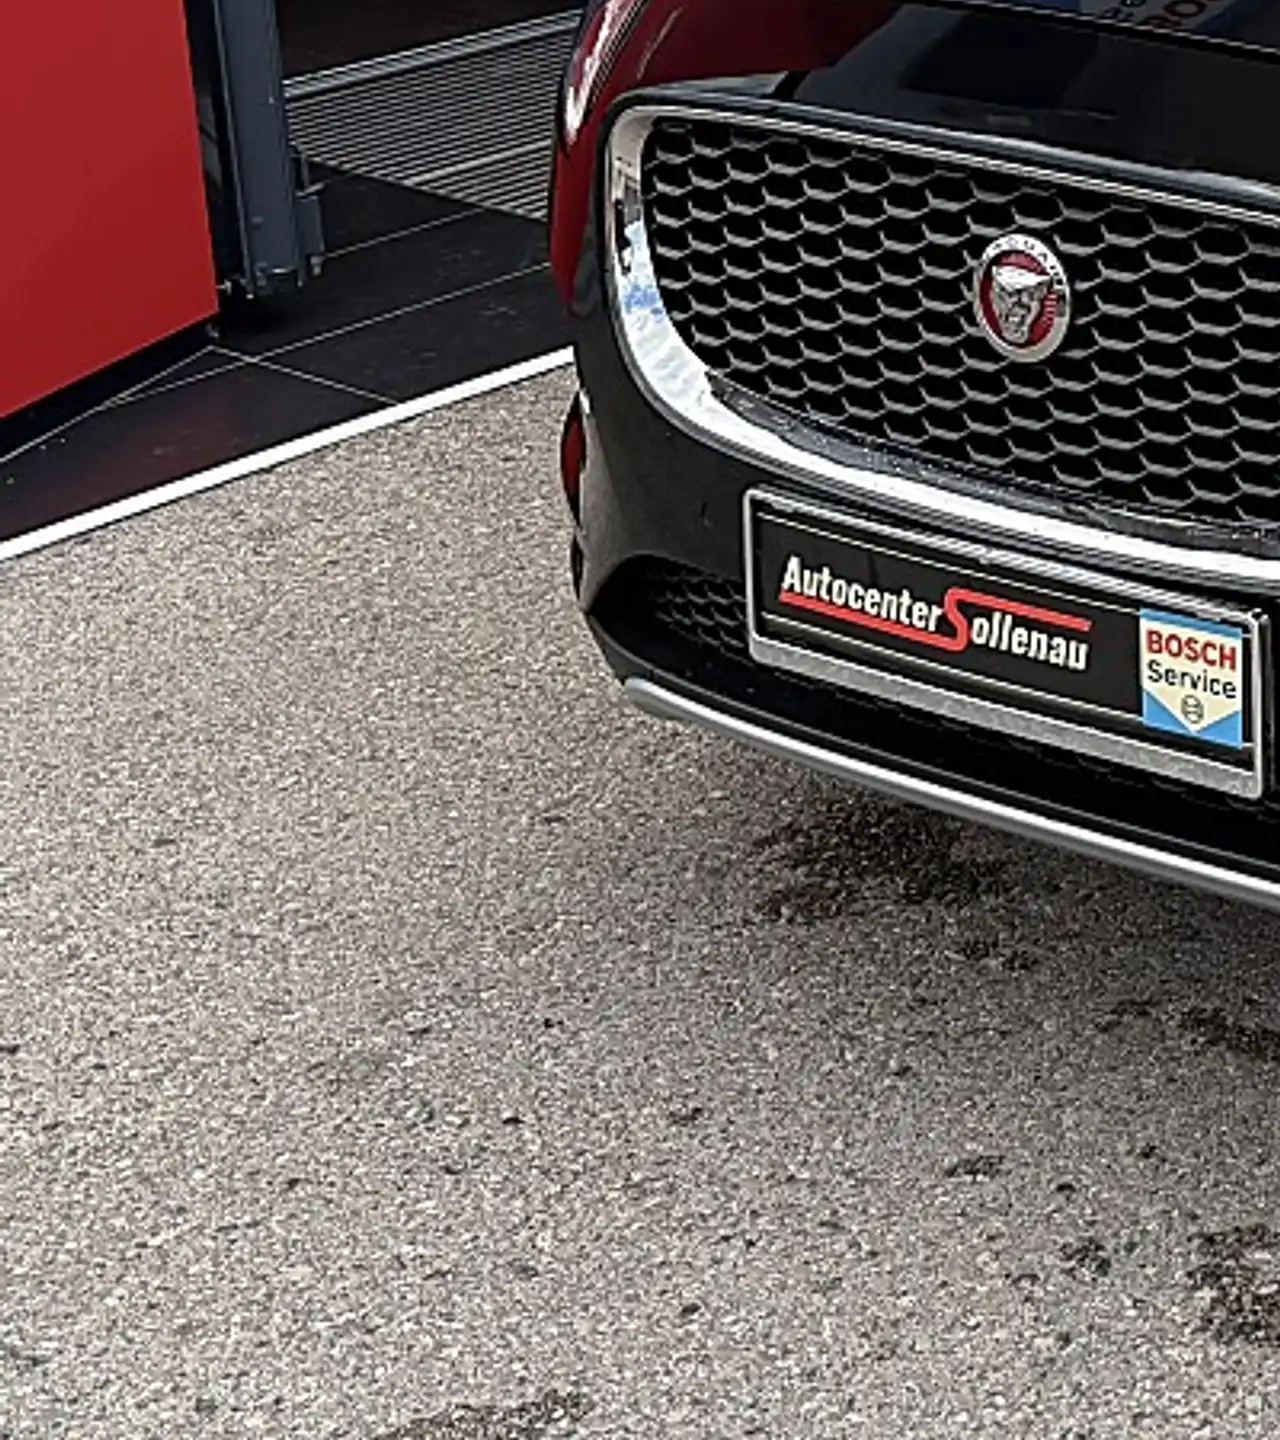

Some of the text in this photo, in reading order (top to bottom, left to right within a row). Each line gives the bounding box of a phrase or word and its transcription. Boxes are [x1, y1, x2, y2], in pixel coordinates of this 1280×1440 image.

[781, 554, 943, 633] Autocenter
[1146, 629, 1237, 671] BOSCH
[1146, 660, 1237, 700] Service
